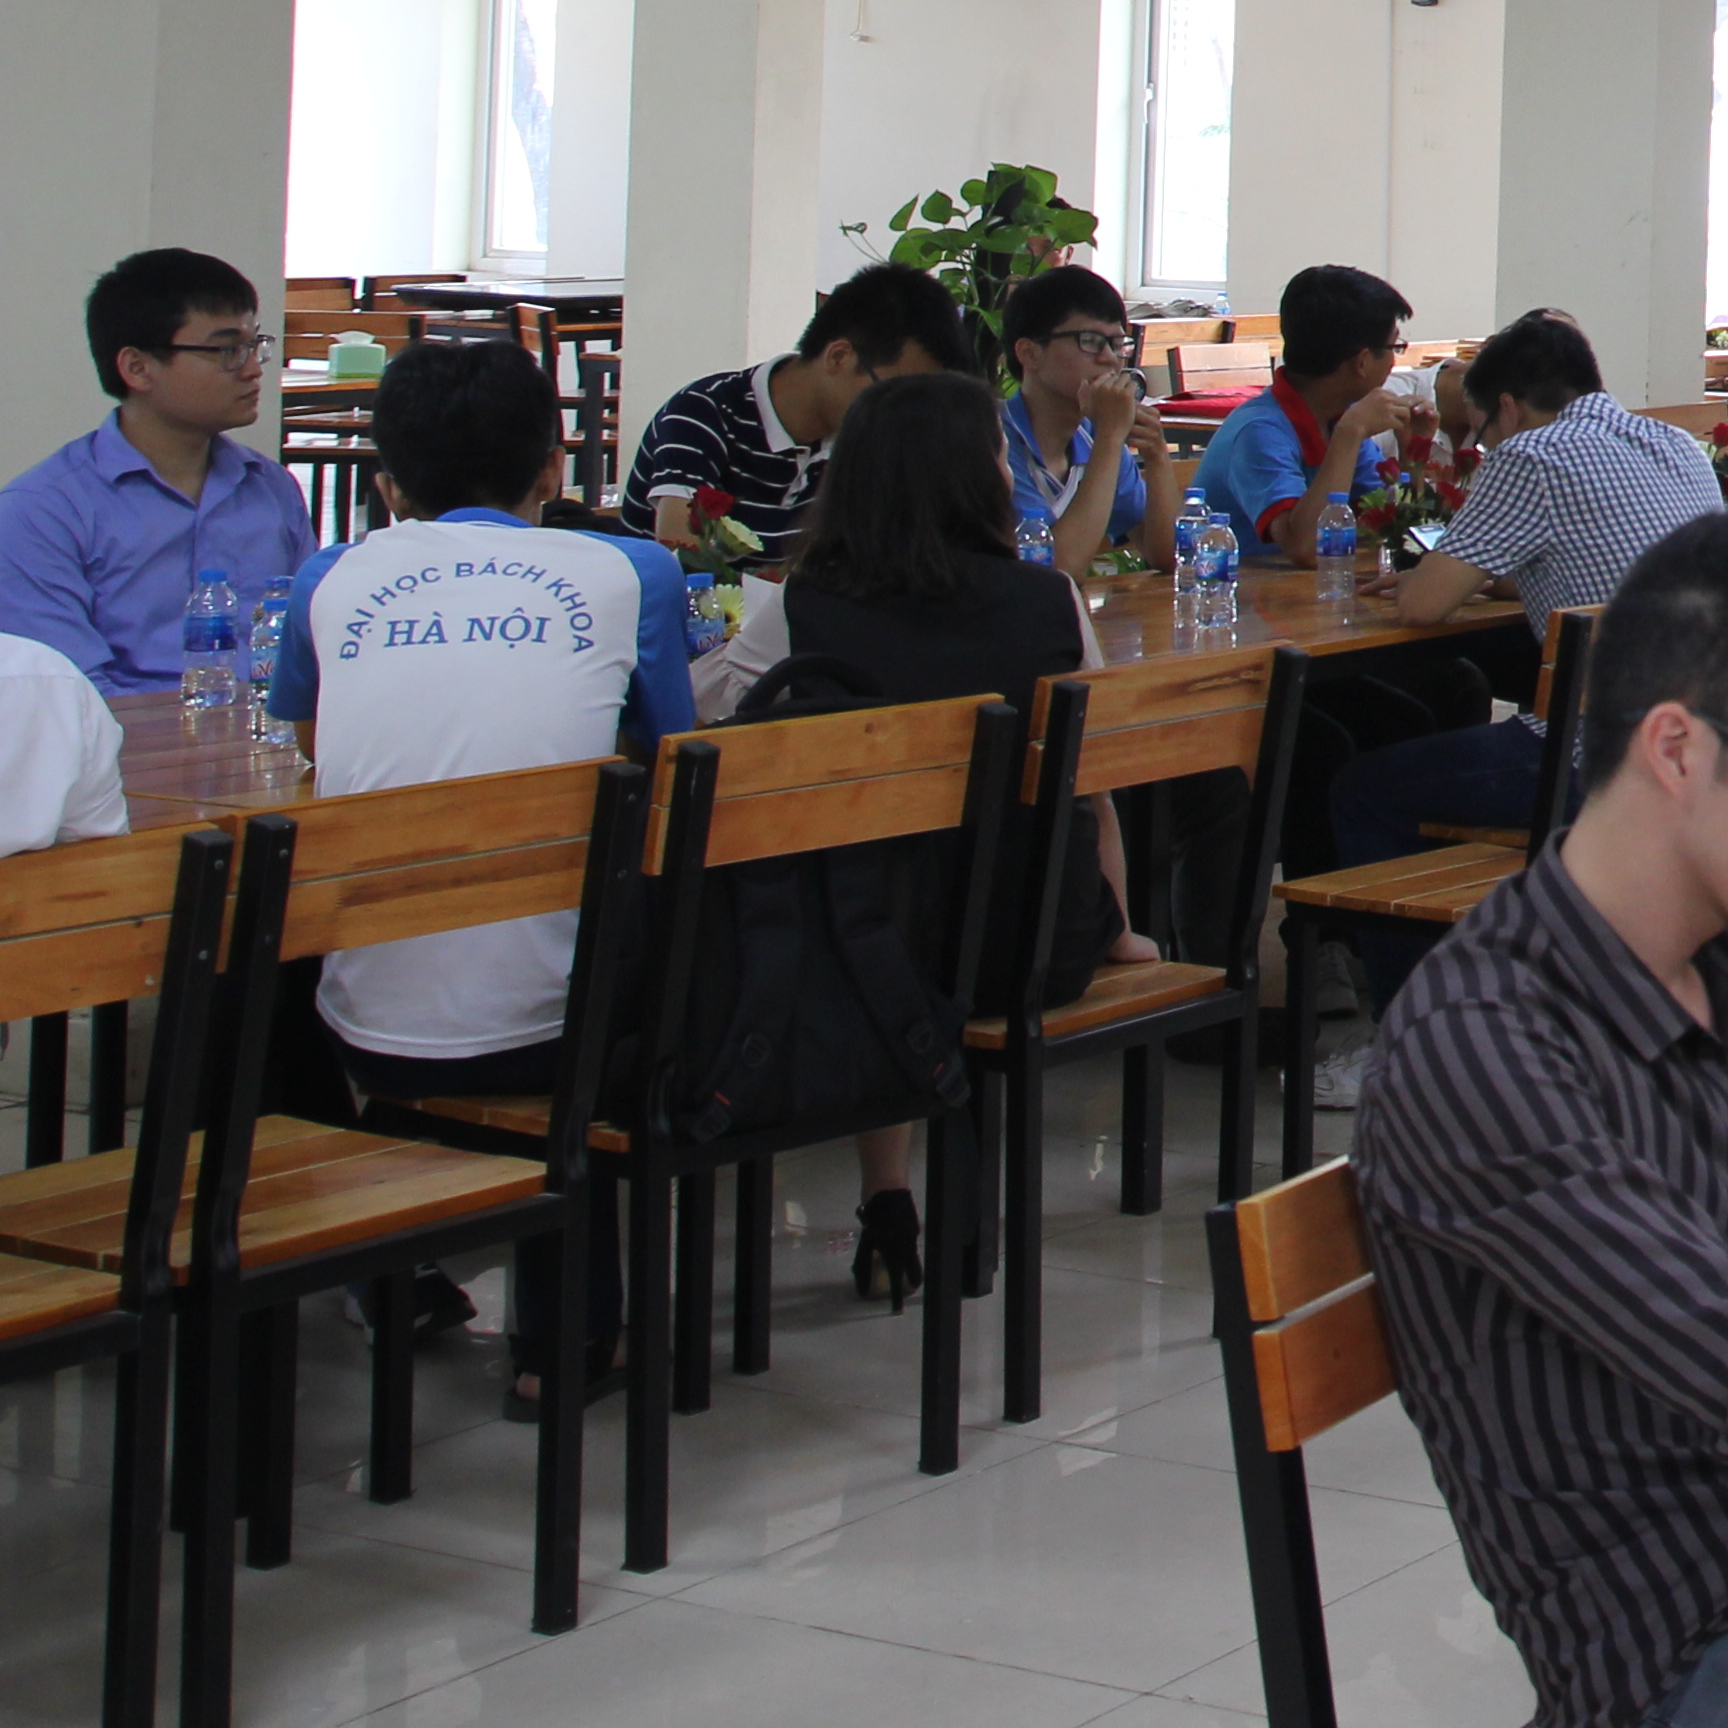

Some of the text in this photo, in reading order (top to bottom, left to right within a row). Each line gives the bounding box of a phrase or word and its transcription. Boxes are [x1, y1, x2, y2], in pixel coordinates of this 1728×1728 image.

[339, 556, 595, 660] ĐẠI HỌC BÁCH KHOA
[383, 607, 552, 649] HÀ NỘI
